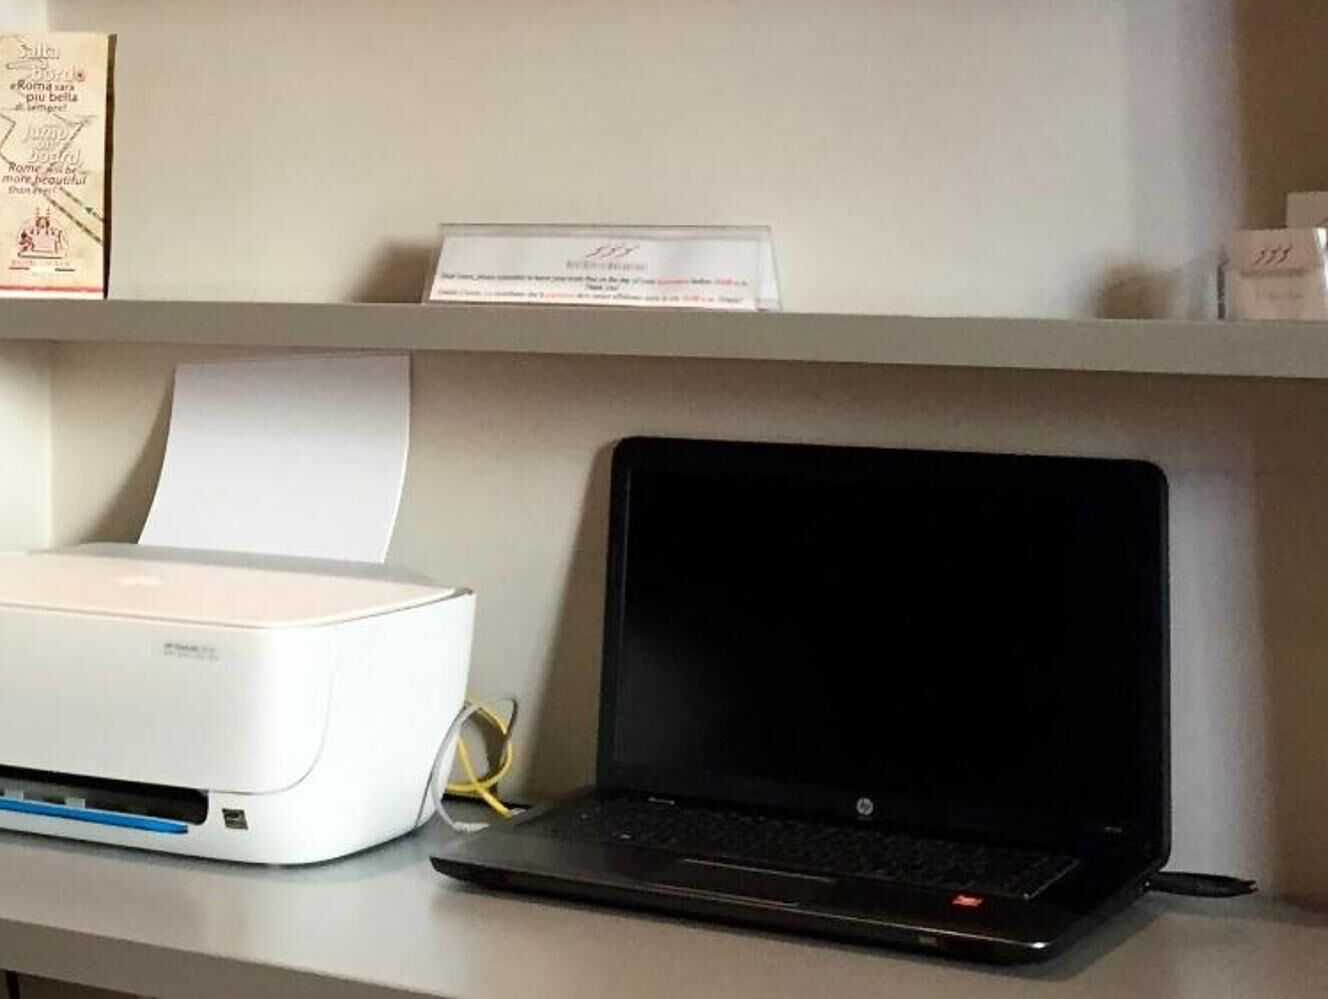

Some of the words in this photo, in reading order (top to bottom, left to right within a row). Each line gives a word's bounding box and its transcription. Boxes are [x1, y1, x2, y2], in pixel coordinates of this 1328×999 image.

[17, 79, 53, 91] Roma
[49, 92, 78, 102] bella
[8, 164, 41, 174] Rome
[2, 175, 32, 183] more
[33, 173, 88, 185] beautiful
